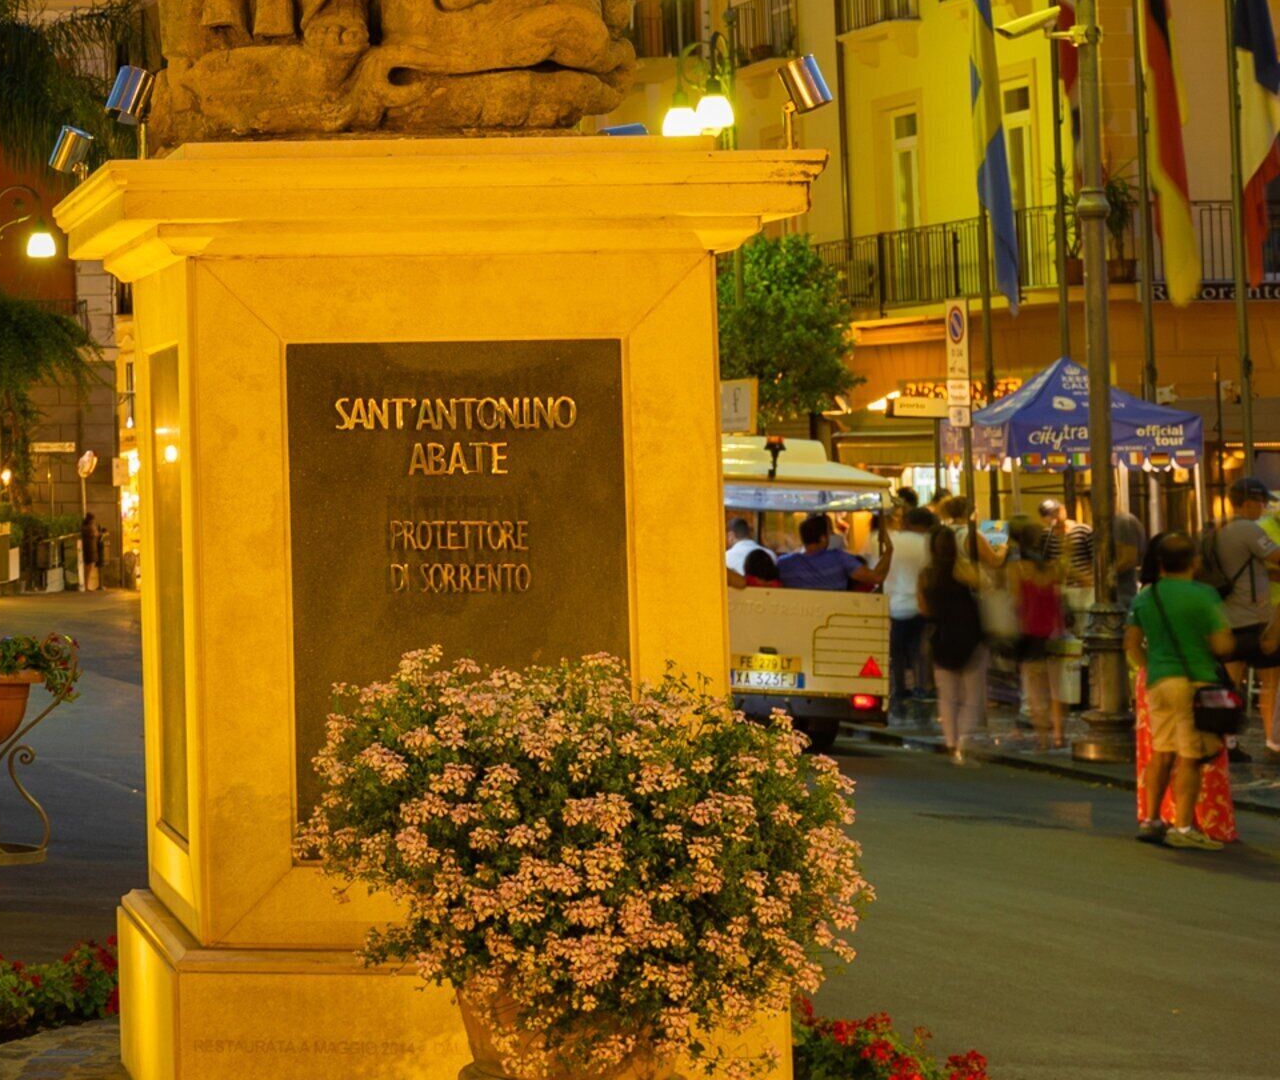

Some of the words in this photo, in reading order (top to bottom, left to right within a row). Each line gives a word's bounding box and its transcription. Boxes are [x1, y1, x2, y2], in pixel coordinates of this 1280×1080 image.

[335, 396, 577, 431] SANT'ANTONINO
[1135, 424, 1185, 438] official
[1155, 434, 1185, 447] tour
[408, 441, 509, 476] ABATE
[390, 520, 529, 551] PROTETTORE
[390, 563, 410, 592] DI
[421, 563, 532, 593] SORRENTO
[759, 657, 778, 670] 279
